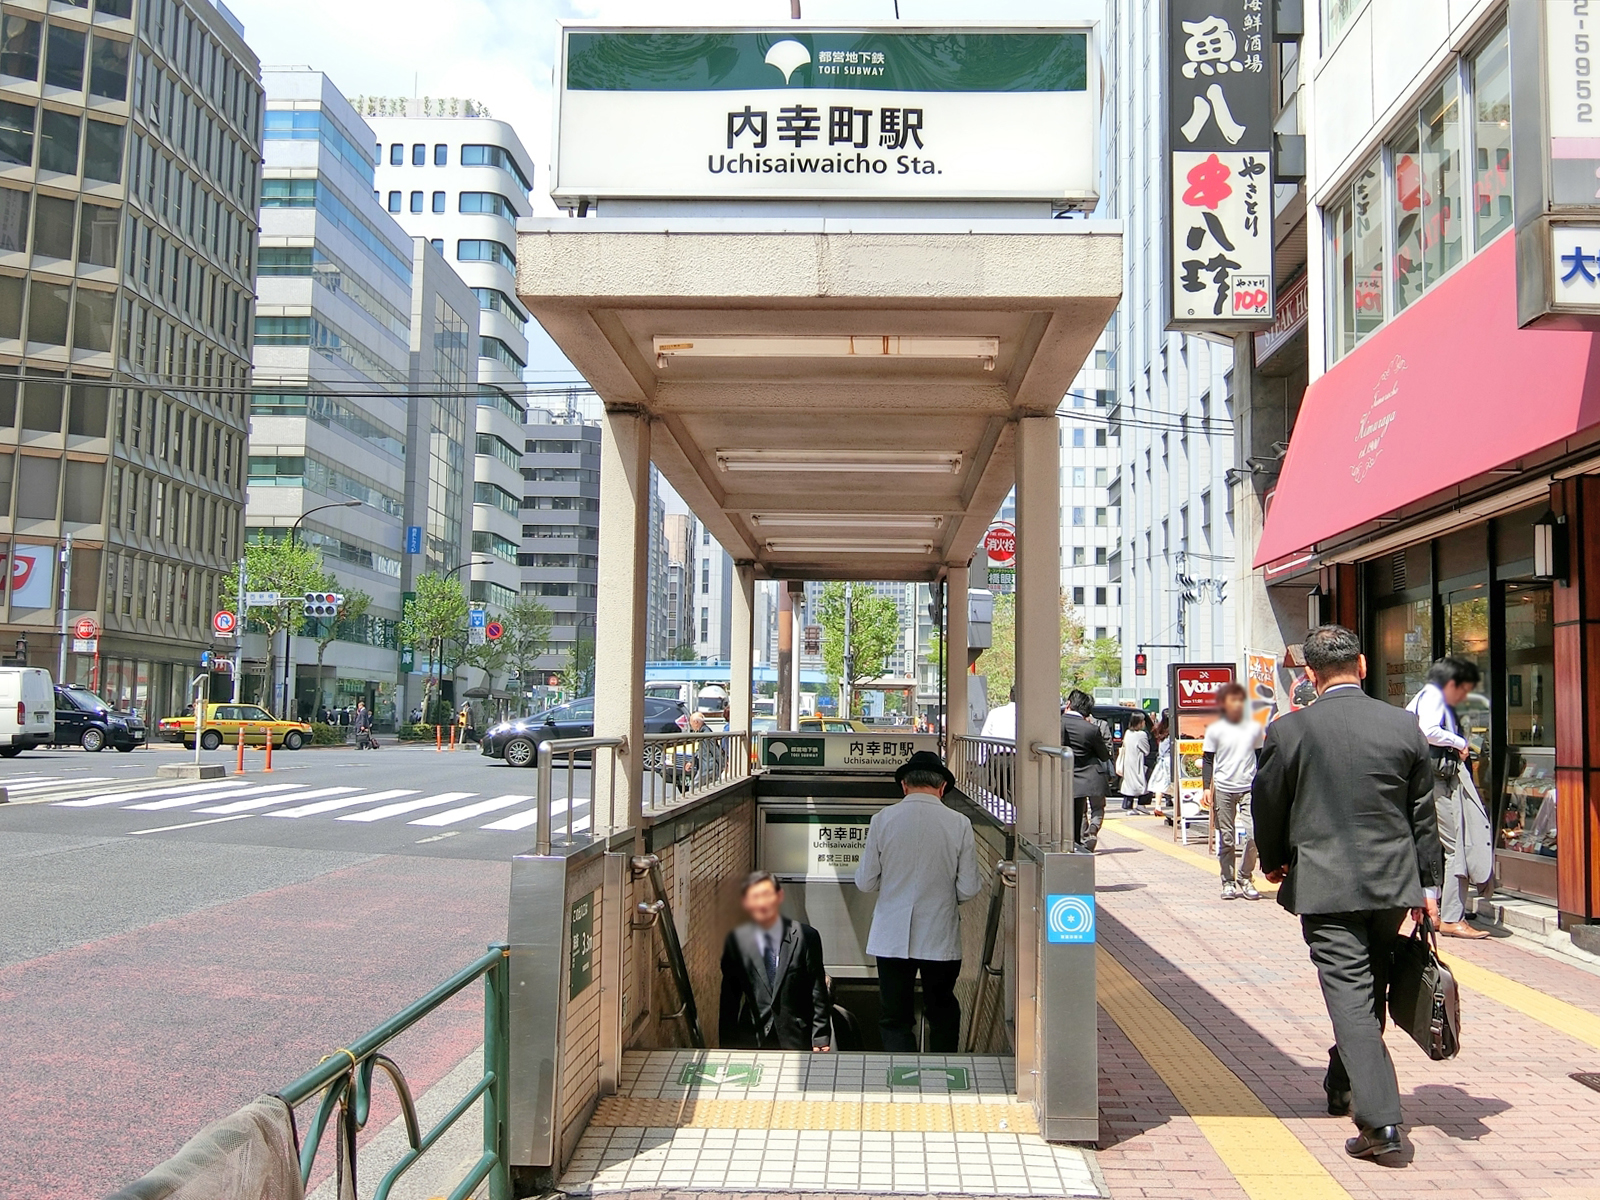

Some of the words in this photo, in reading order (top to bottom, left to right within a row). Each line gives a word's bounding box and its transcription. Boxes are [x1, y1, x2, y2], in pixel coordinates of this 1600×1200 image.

[1243, 0, 1263, 73] 海鮮酒場
[818, 51, 885, 64] 都営地下鉄
[818, 66, 840, 74] TOEI
[844, 66, 885, 76] SUBWAY
[1180, 15, 1247, 145] 魚八
[726, 104, 924, 150] 内幸町駅
[708, 153, 888, 175] Uchisaiwaicho
[896, 155, 943, 175] Sta.
[1238, 156, 1266, 237] やきとり
[1180, 153, 1242, 315] 串八珍
[1561, 246, 1600, 284] 大
[1236, 279, 1265, 288] やきとり
[1234, 289, 1268, 312] 100
[987, 538, 1014, 552] 消火栓
[850, 741, 914, 756] 内幸町駅
[843, 757, 903, 765] Uchisaiwaicho
[818, 854, 860, 862] 都営三田線
